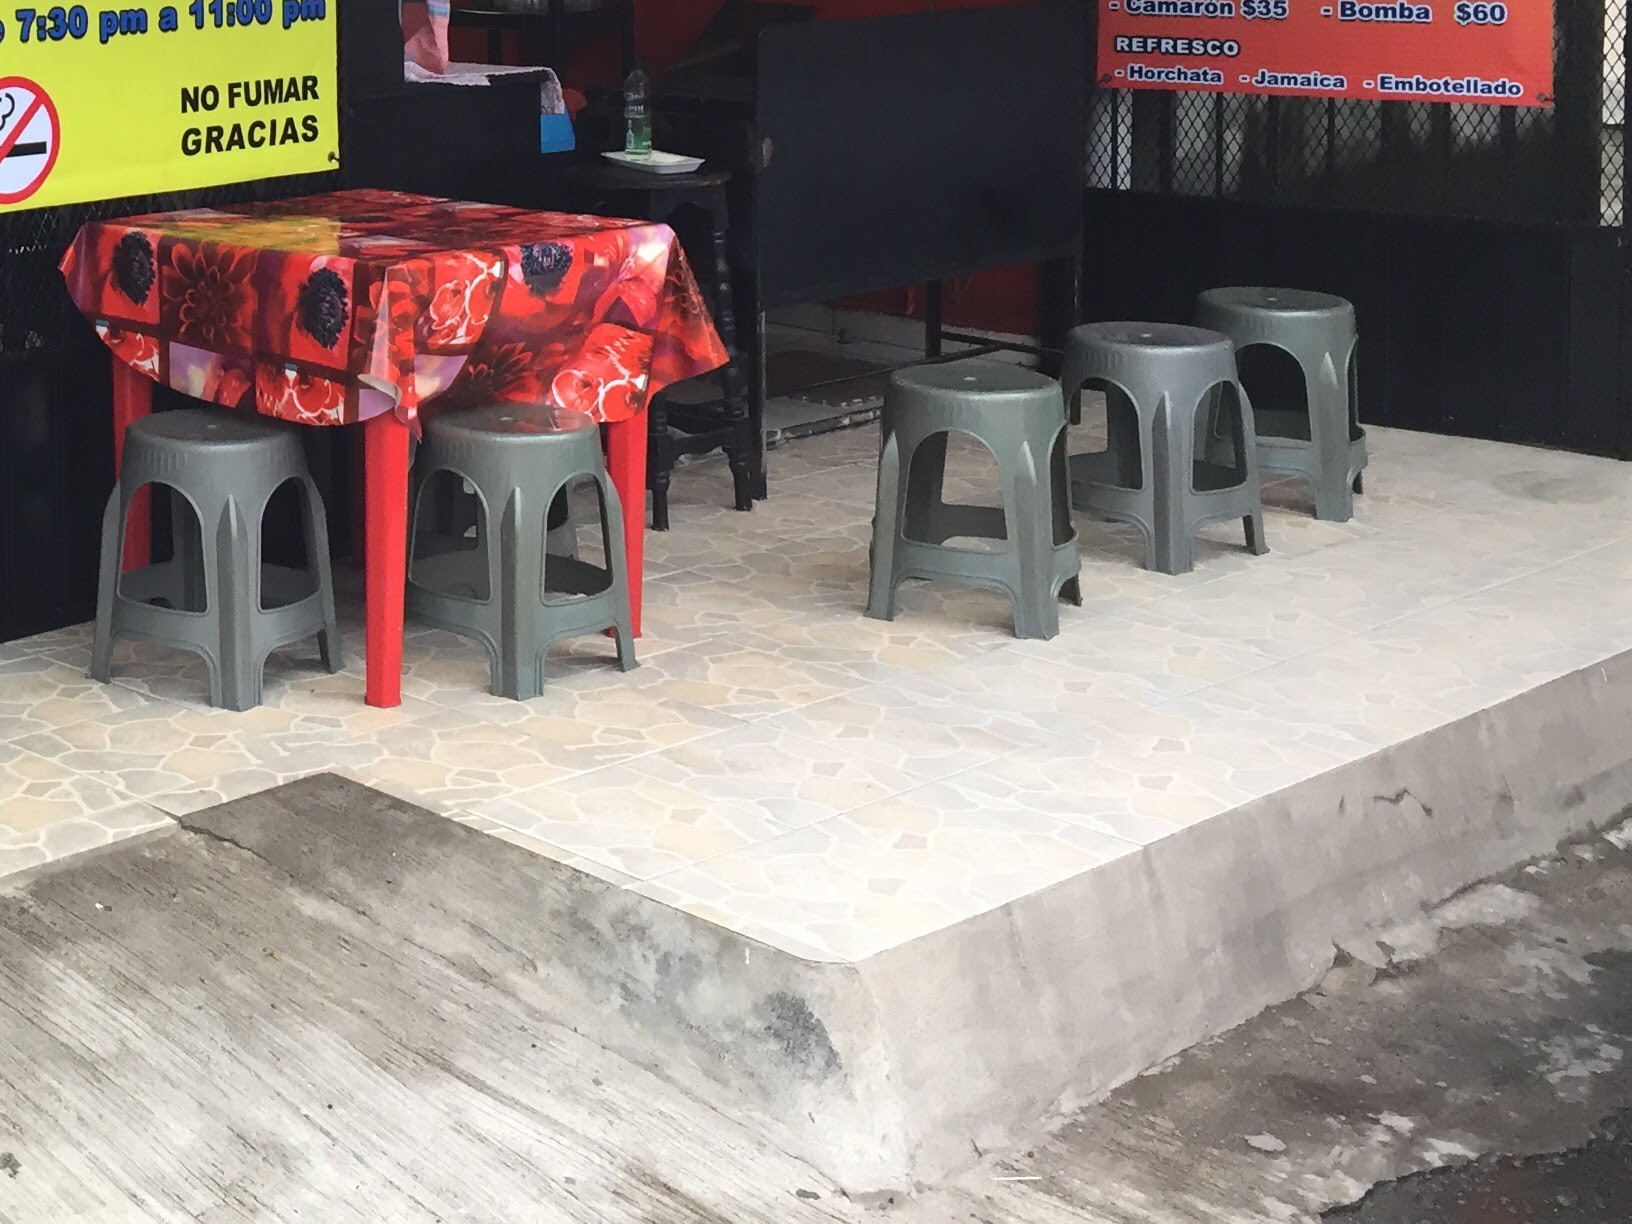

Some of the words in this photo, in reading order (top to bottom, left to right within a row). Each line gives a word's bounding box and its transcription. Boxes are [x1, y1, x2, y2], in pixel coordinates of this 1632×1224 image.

[15, 5, 89, 42] 7:30
[99, 8, 149, 44] pm
[158, 5, 178, 32] a
[1453, 1, 1508, 26] $60
[1115, 35, 1242, 58] REFRESCO
[180, 86, 220, 114] NO
[227, 74, 320, 109] FUMAR
[1127, 63, 1224, 85] Horchata
[1252, 68, 1347, 90] Jamaica
[1377, 74, 1524, 98] Embotellado
[180, 114, 320, 157] GRACIAS
